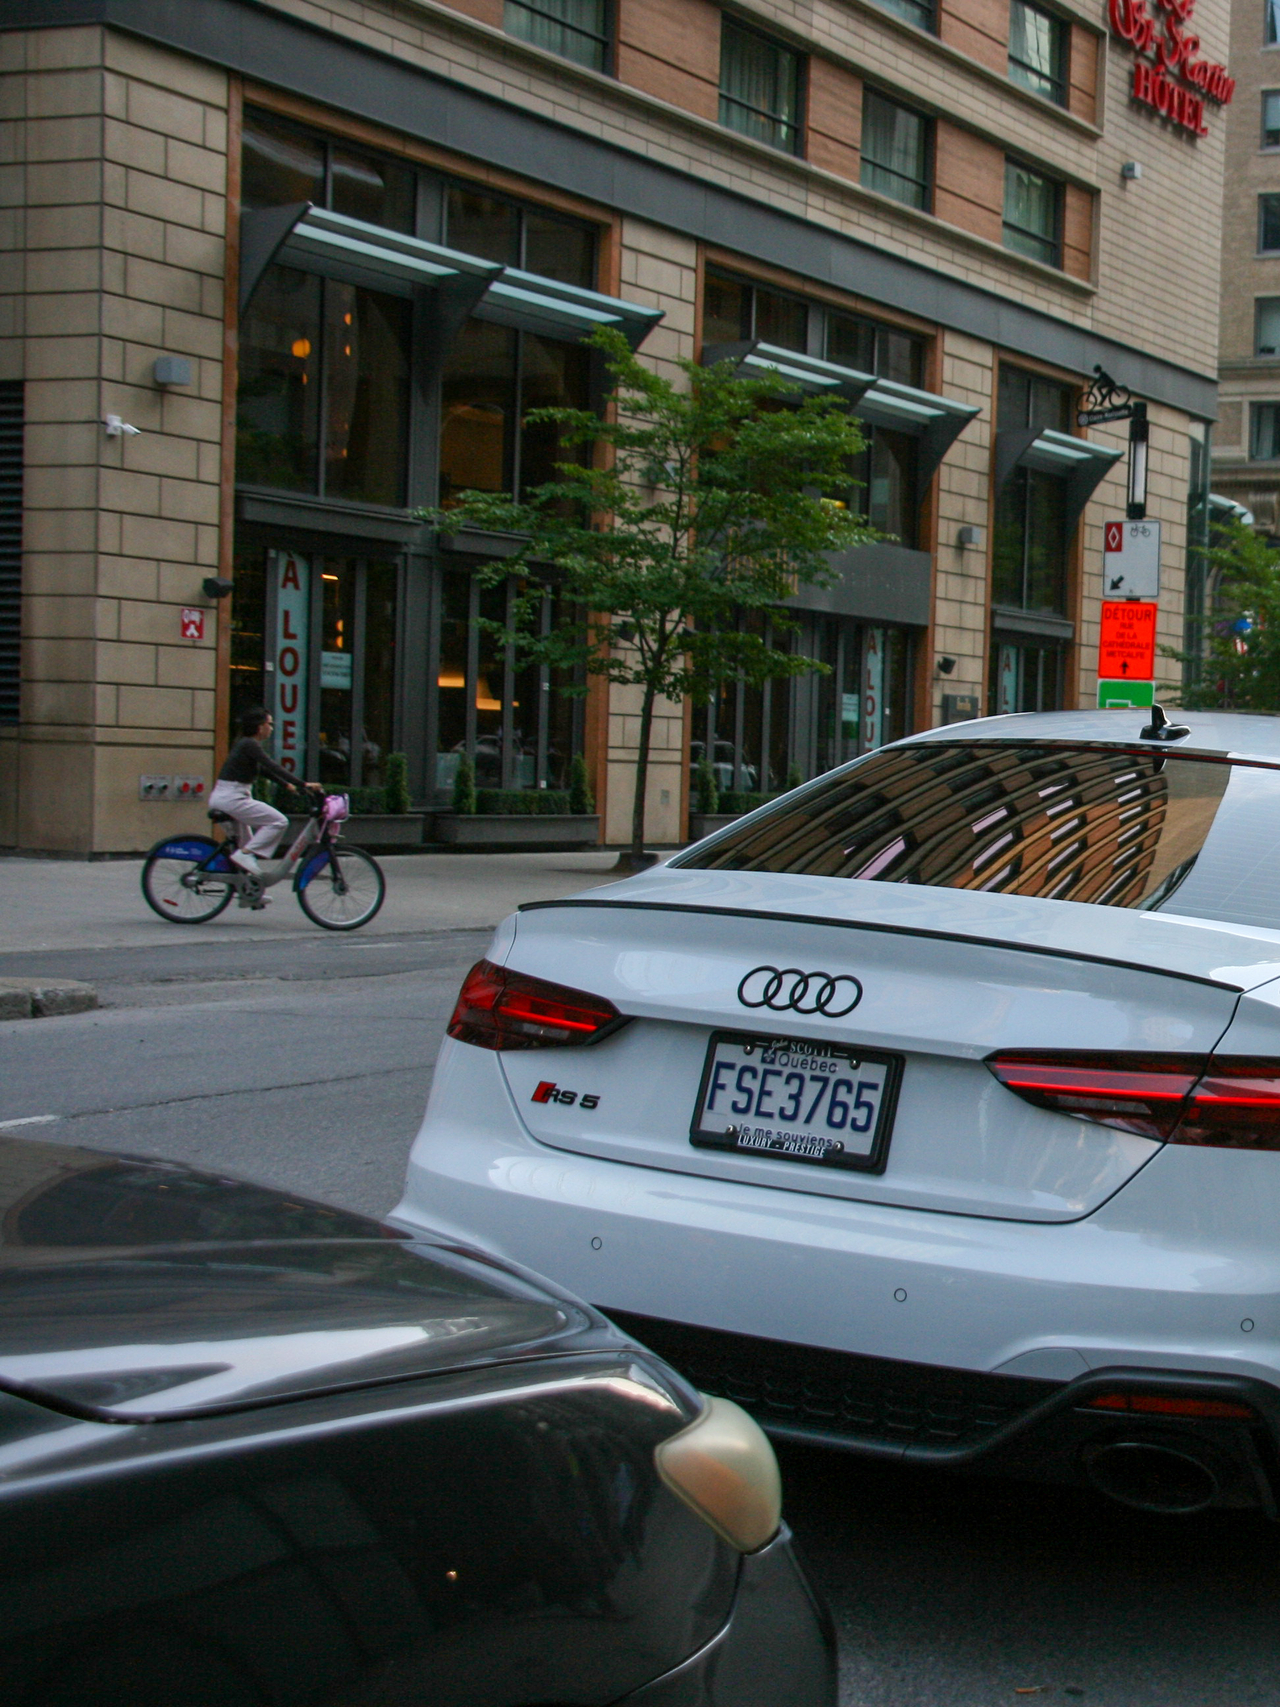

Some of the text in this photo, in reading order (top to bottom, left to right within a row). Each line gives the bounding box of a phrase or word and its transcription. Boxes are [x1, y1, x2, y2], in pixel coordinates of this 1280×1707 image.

[1104, 605, 1152, 621] DÉTOUR
[1119, 622, 1135, 630] RUE
[1115, 631, 1138, 640] DE LA
[1102, 640, 1151, 650] CATHÉDRALE
[1106, 650, 1145, 659] METCALFE
[778, 1052, 837, 1074] Québec
[579, 1094, 601, 1110] 5
[706, 1060, 879, 1133] FSE3765
[737, 1122, 833, 1148] Je me souviens
[738, 1135, 772, 1148] LUXURY
[783, 1141, 826, 1158] PRESTIGE
